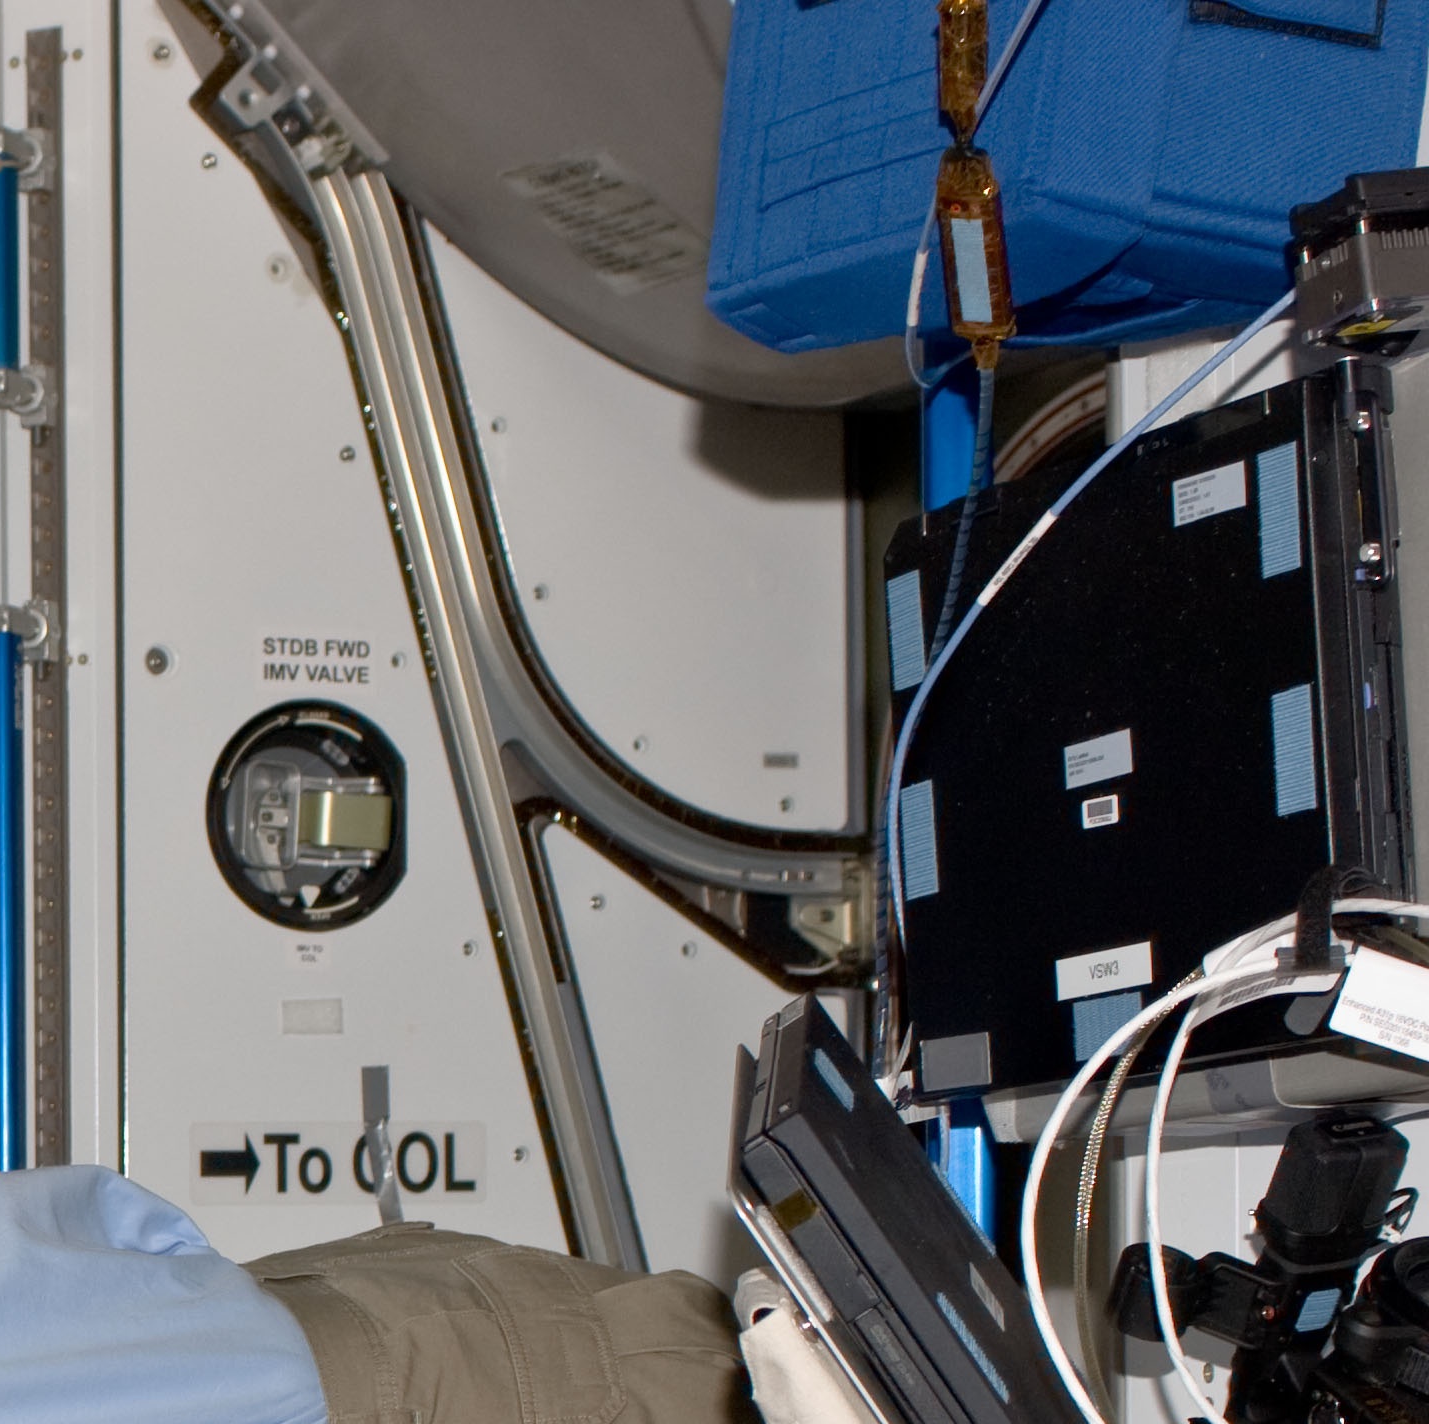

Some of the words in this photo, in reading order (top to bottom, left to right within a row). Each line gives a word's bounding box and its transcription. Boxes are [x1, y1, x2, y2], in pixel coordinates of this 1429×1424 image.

[263, 637, 318, 656] STDB
[324, 640, 370, 658] FWD
[263, 663, 299, 681] IMV
[306, 666, 370, 683] VALVE
[1088, 960, 1119, 980] VSW3
[263, 1133, 333, 1193] To
